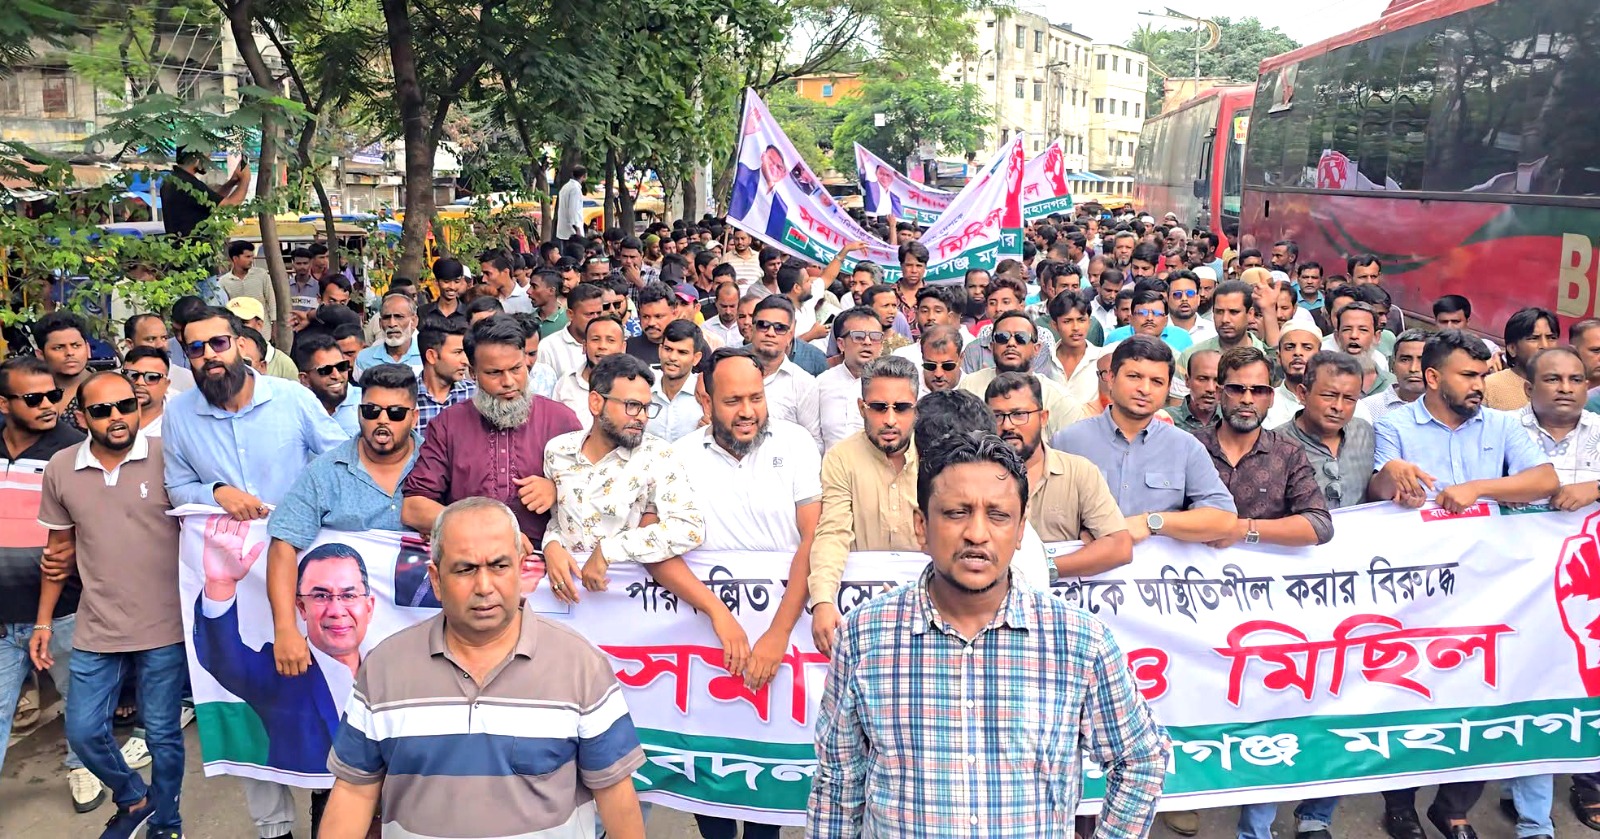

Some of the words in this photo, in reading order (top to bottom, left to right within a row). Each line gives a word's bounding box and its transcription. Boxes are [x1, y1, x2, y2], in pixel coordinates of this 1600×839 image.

[1556, 232, 1600, 318] B
[1134, 563, 1274, 623] অস্থিতিশীল
[1283, 568, 1359, 608] করার
[1367, 556, 1459, 605] বিরুদ্ধে
[1213, 613, 1517, 707] মিছিল
[1327, 707, 1600, 759] মহানগ
